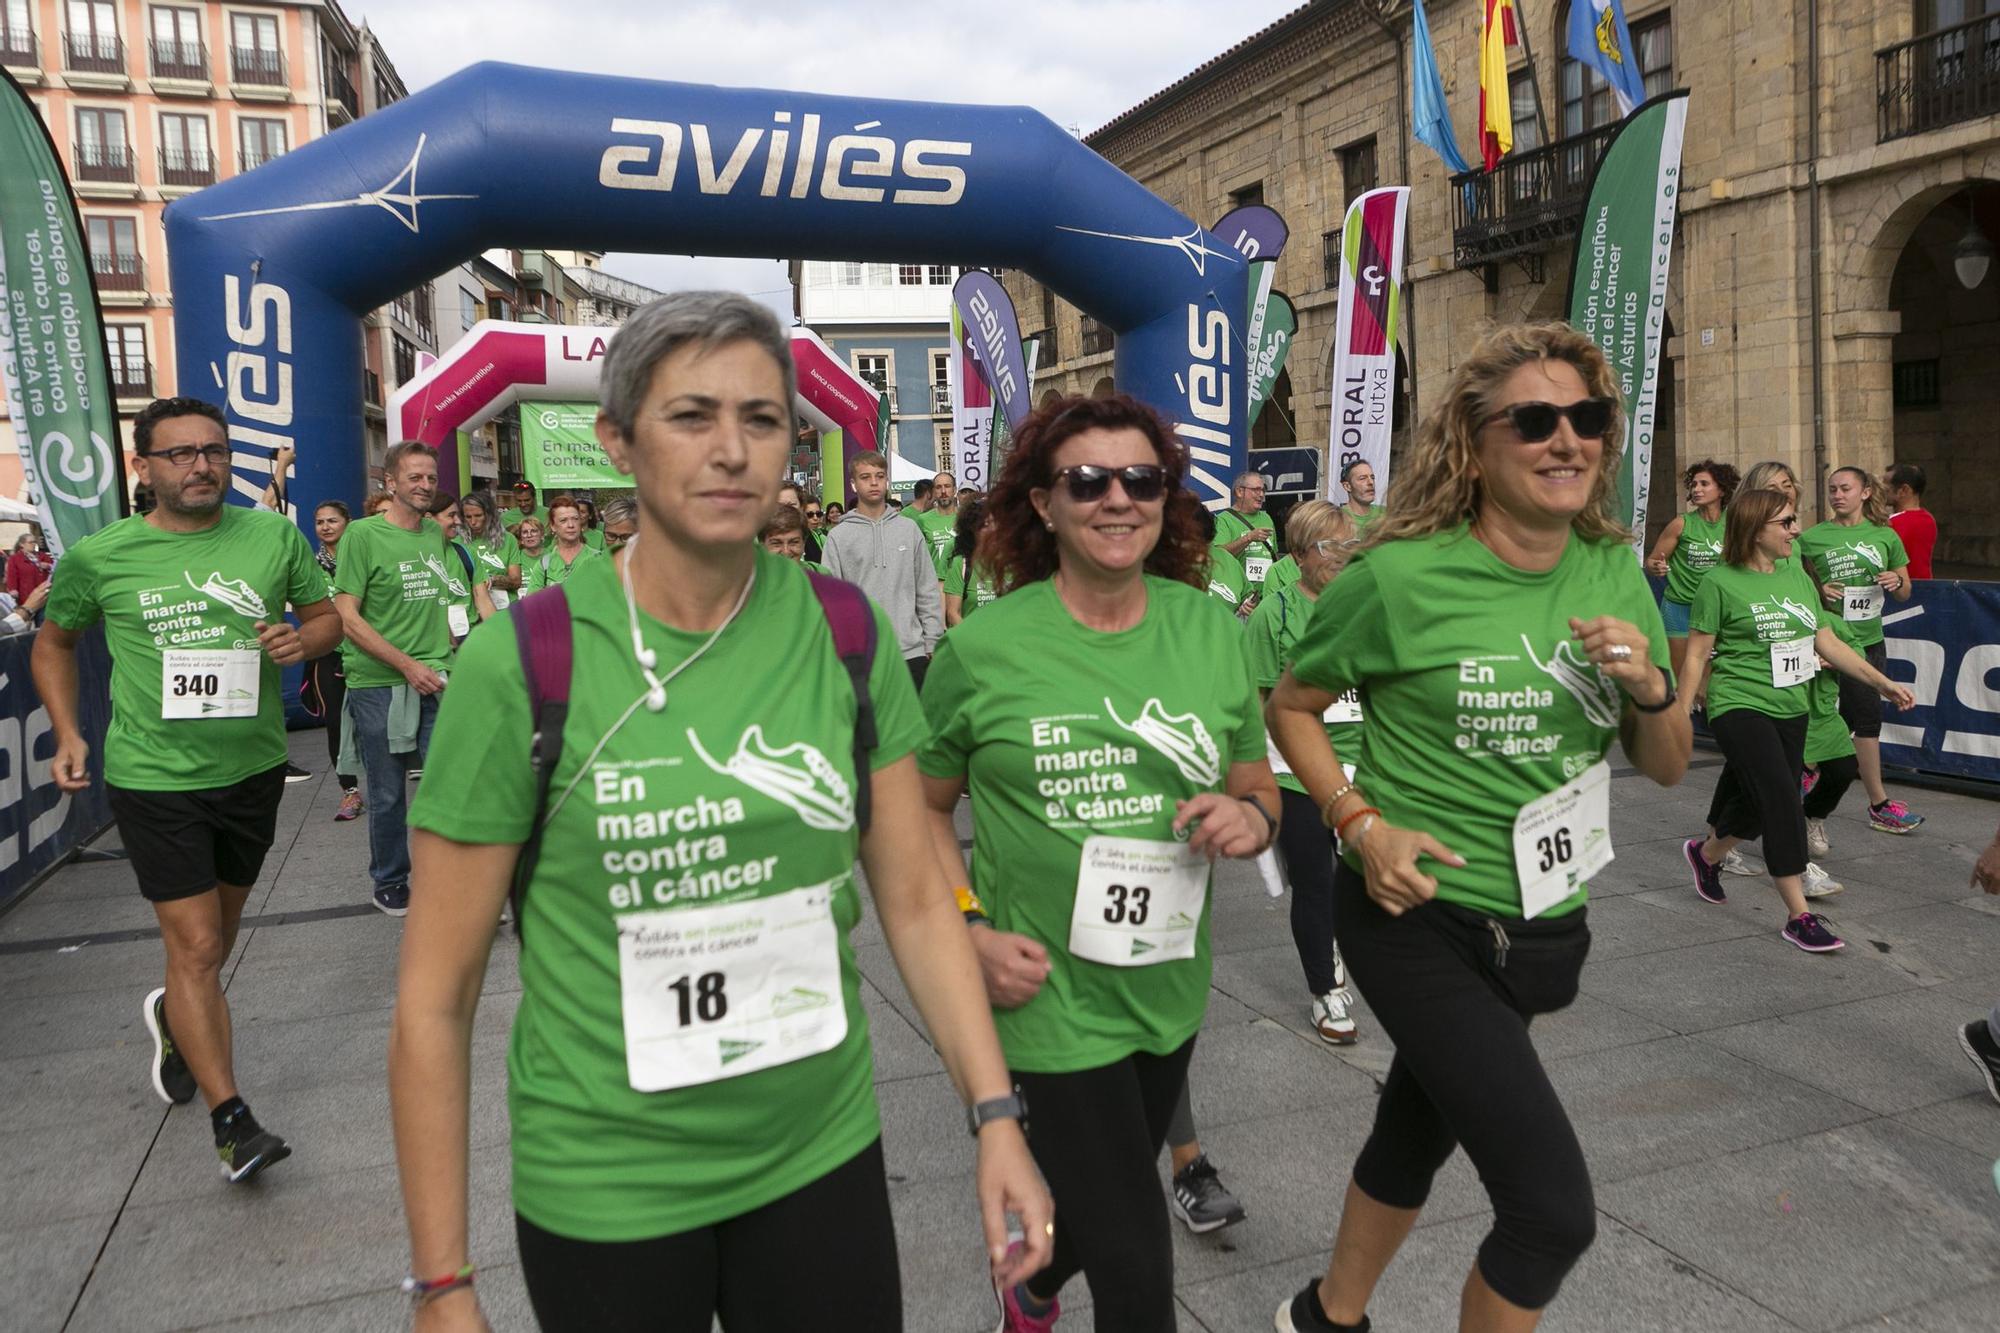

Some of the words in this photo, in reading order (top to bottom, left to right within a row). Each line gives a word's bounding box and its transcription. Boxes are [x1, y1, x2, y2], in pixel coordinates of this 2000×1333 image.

[599, 111, 972, 206] avilés
[1590, 205, 1609, 290] española
[1603, 243, 1623, 310] cáncer
[1601, 311, 1616, 331] el
[1619, 291, 1637, 373] Asturias
[434, 394, 457, 411] banka
[453, 362, 495, 396] kooperatiboa
[810, 368, 828, 386] banca
[826, 383, 858, 410] cooperativa
[1623, 373, 1634, 396] en
[1368, 368, 1388, 425] kutxa
[543, 440, 562, 452] En
[964, 418, 981, 491] ORAL
[543, 454, 596, 466] contra
[1825, 551, 1837, 560] En
[1827, 553, 1858, 566] marcha
[1829, 561, 1855, 572] contra
[400, 563, 412, 572] En
[401, 570, 431, 581] marcha
[1249, 565, 1263, 574] 292
[1830, 571, 1838, 579] el
[1839, 567, 1867, 577] cáncer
[402, 580, 429, 590] contra
[403, 589, 412, 598] el
[413, 587, 440, 597] cáncer
[139, 591, 163, 607] En
[142, 600, 208, 621] marcha
[1751, 605, 1766, 614] En
[1849, 598, 1871, 610] 442
[147, 615, 202, 633] contra
[1754, 611, 1790, 622] marcha
[1756, 621, 1786, 631] contra
[153, 631, 168, 646] el
[170, 625, 227, 644] cáncer
[1758, 630, 1767, 639] el
[1768, 630, 1797, 638] cáncer
[1459, 660, 1496, 684] En
[1782, 656, 1800, 673] 711
[173, 674, 218, 697] 340
[1457, 685, 1554, 710] marcha
[1032, 722, 1071, 747] En
[1456, 713, 1538, 733] contra
[1455, 733, 1478, 750] el
[1486, 733, 1563, 757] cáncer
[1034, 742, 1138, 773] marcha
[594, 769, 646, 805] En
[1038, 770, 1128, 797] contra
[597, 795, 745, 841] marcha
[1045, 799, 1069, 820] el
[1075, 792, 1164, 821] cáncer
[602, 834, 728, 874] contra
[1536, 826, 1573, 873] 36
[608, 877, 643, 908] el
[653, 855, 779, 904] cáncer
[1103, 884, 1151, 925] 33
[667, 970, 729, 1028] 18
